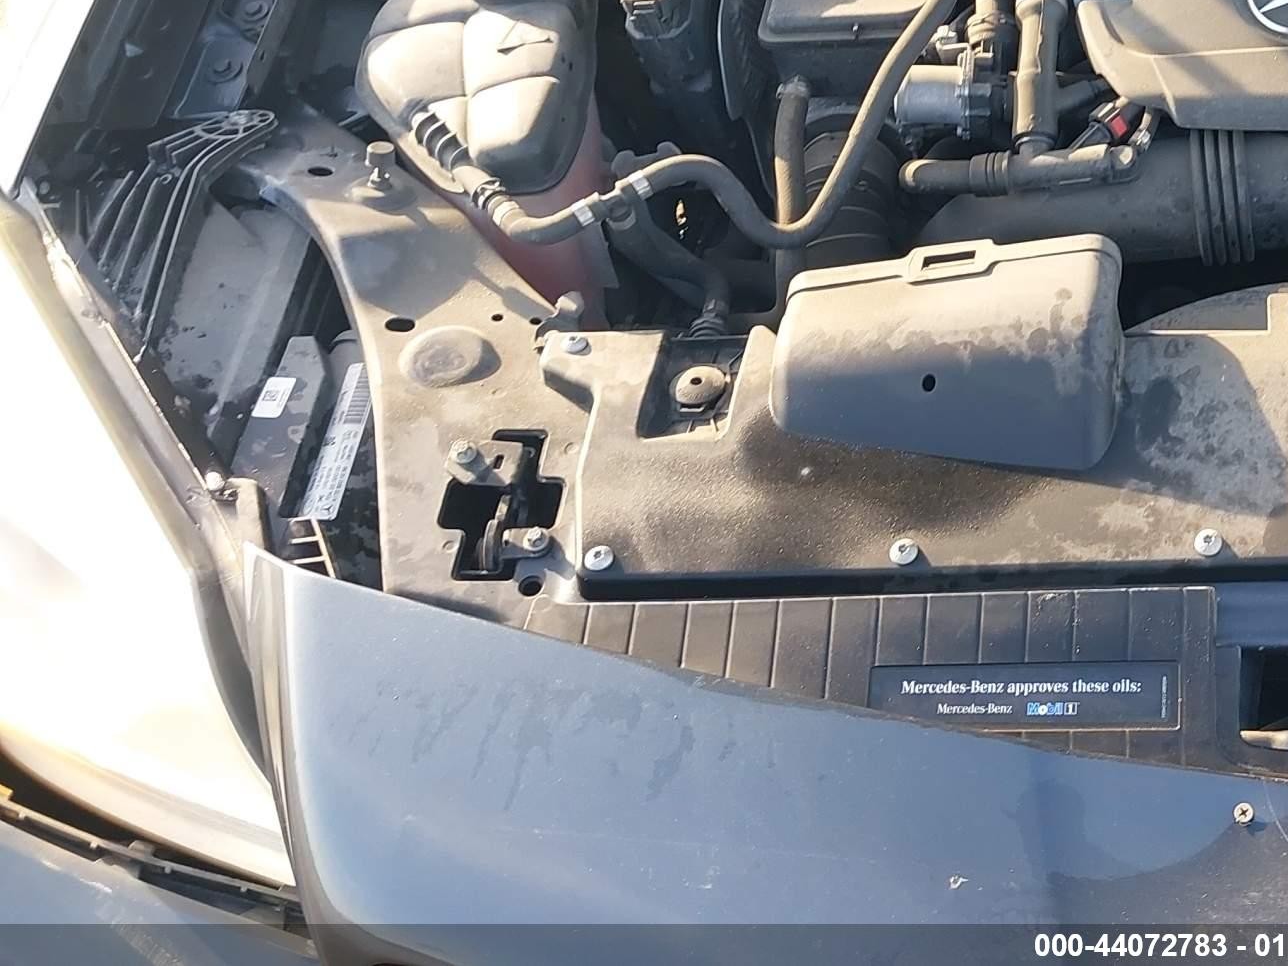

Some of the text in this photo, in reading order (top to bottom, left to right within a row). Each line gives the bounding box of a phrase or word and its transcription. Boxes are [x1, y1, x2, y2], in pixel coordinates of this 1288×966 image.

[900, 679, 1142, 697] Mercedes-Benz approves these oils:
[936, 702, 1013, 715] Mercedes-Benz
[1026, 702, 1064, 716] Mobil
